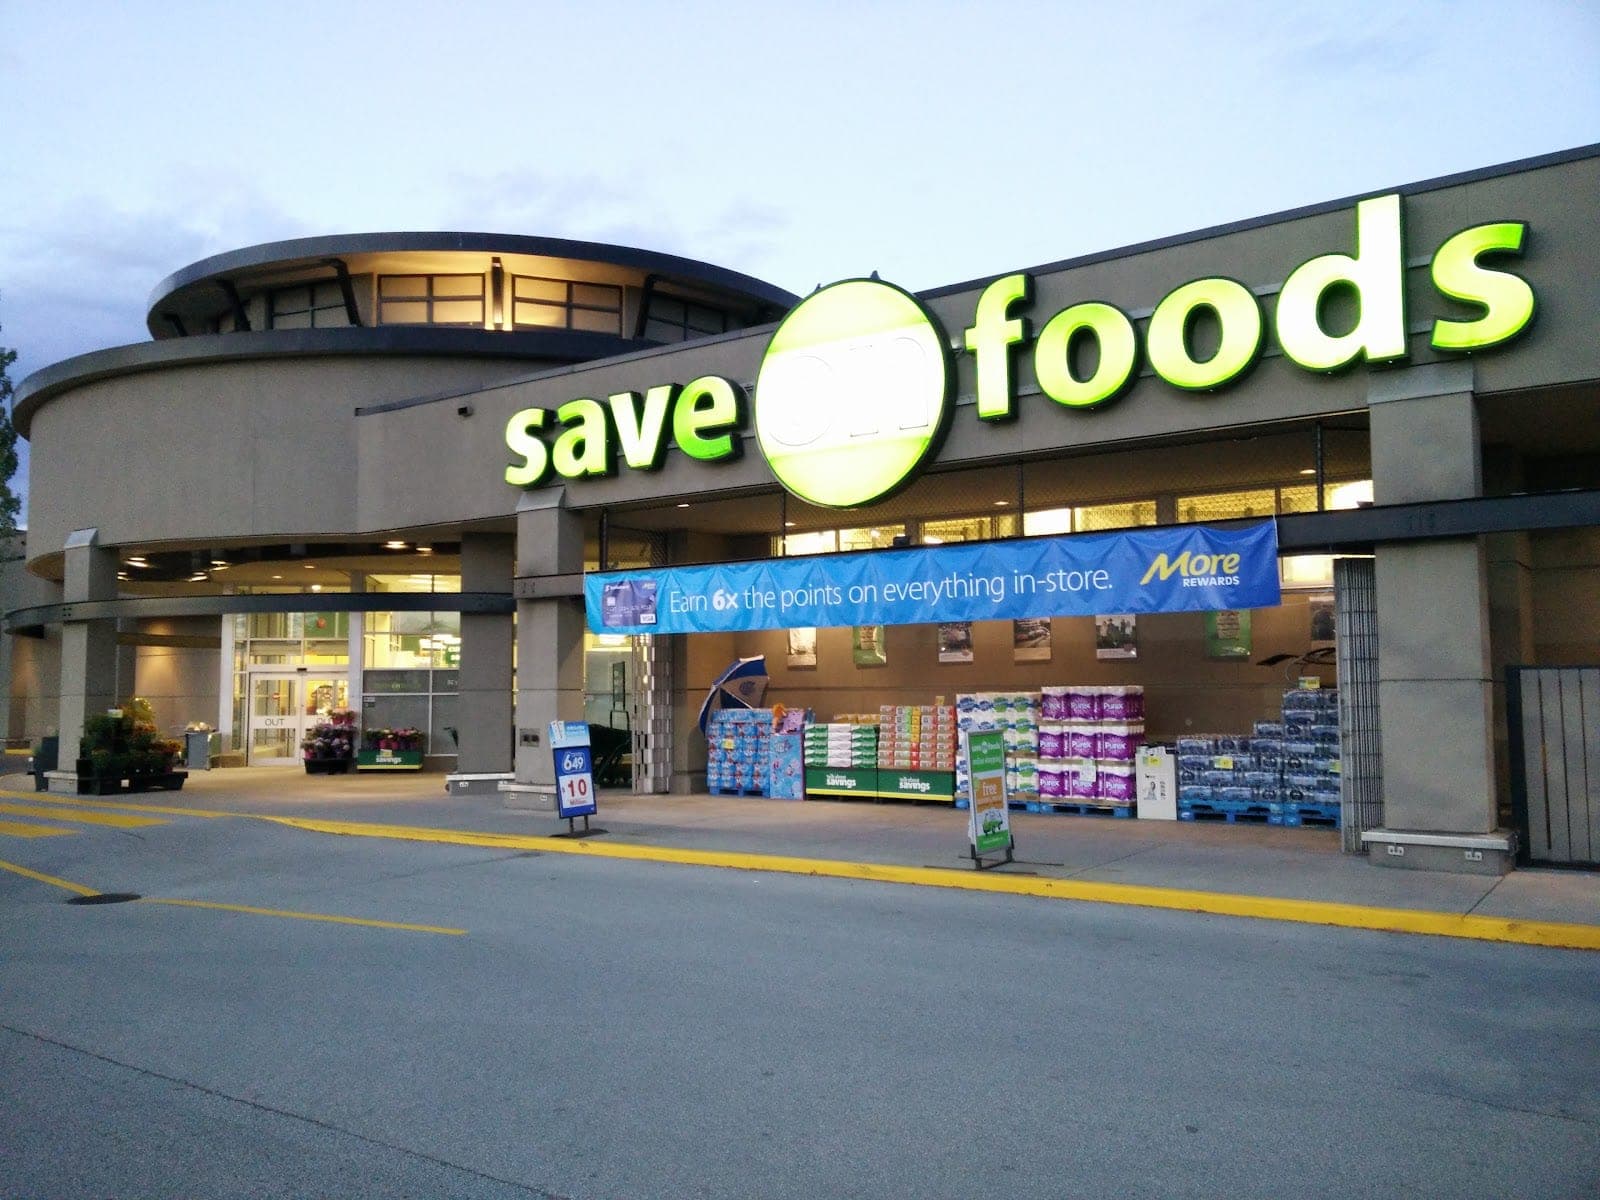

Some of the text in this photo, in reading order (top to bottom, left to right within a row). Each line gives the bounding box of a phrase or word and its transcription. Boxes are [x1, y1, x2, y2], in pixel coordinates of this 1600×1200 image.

[505, 375, 742, 486] save
[964, 193, 1535, 420] foods
[1140, 551, 1240, 585] More
[1183, 576, 1240, 587] REWARDS
[670, 569, 1113, 613] Earn 6x the points on everything in-store.
[264, 718, 285, 726] OUT
[567, 778, 588, 798] 10
[825, 778, 856, 788] savings
[898, 780, 931, 792] savings
[982, 782, 998, 797] free
